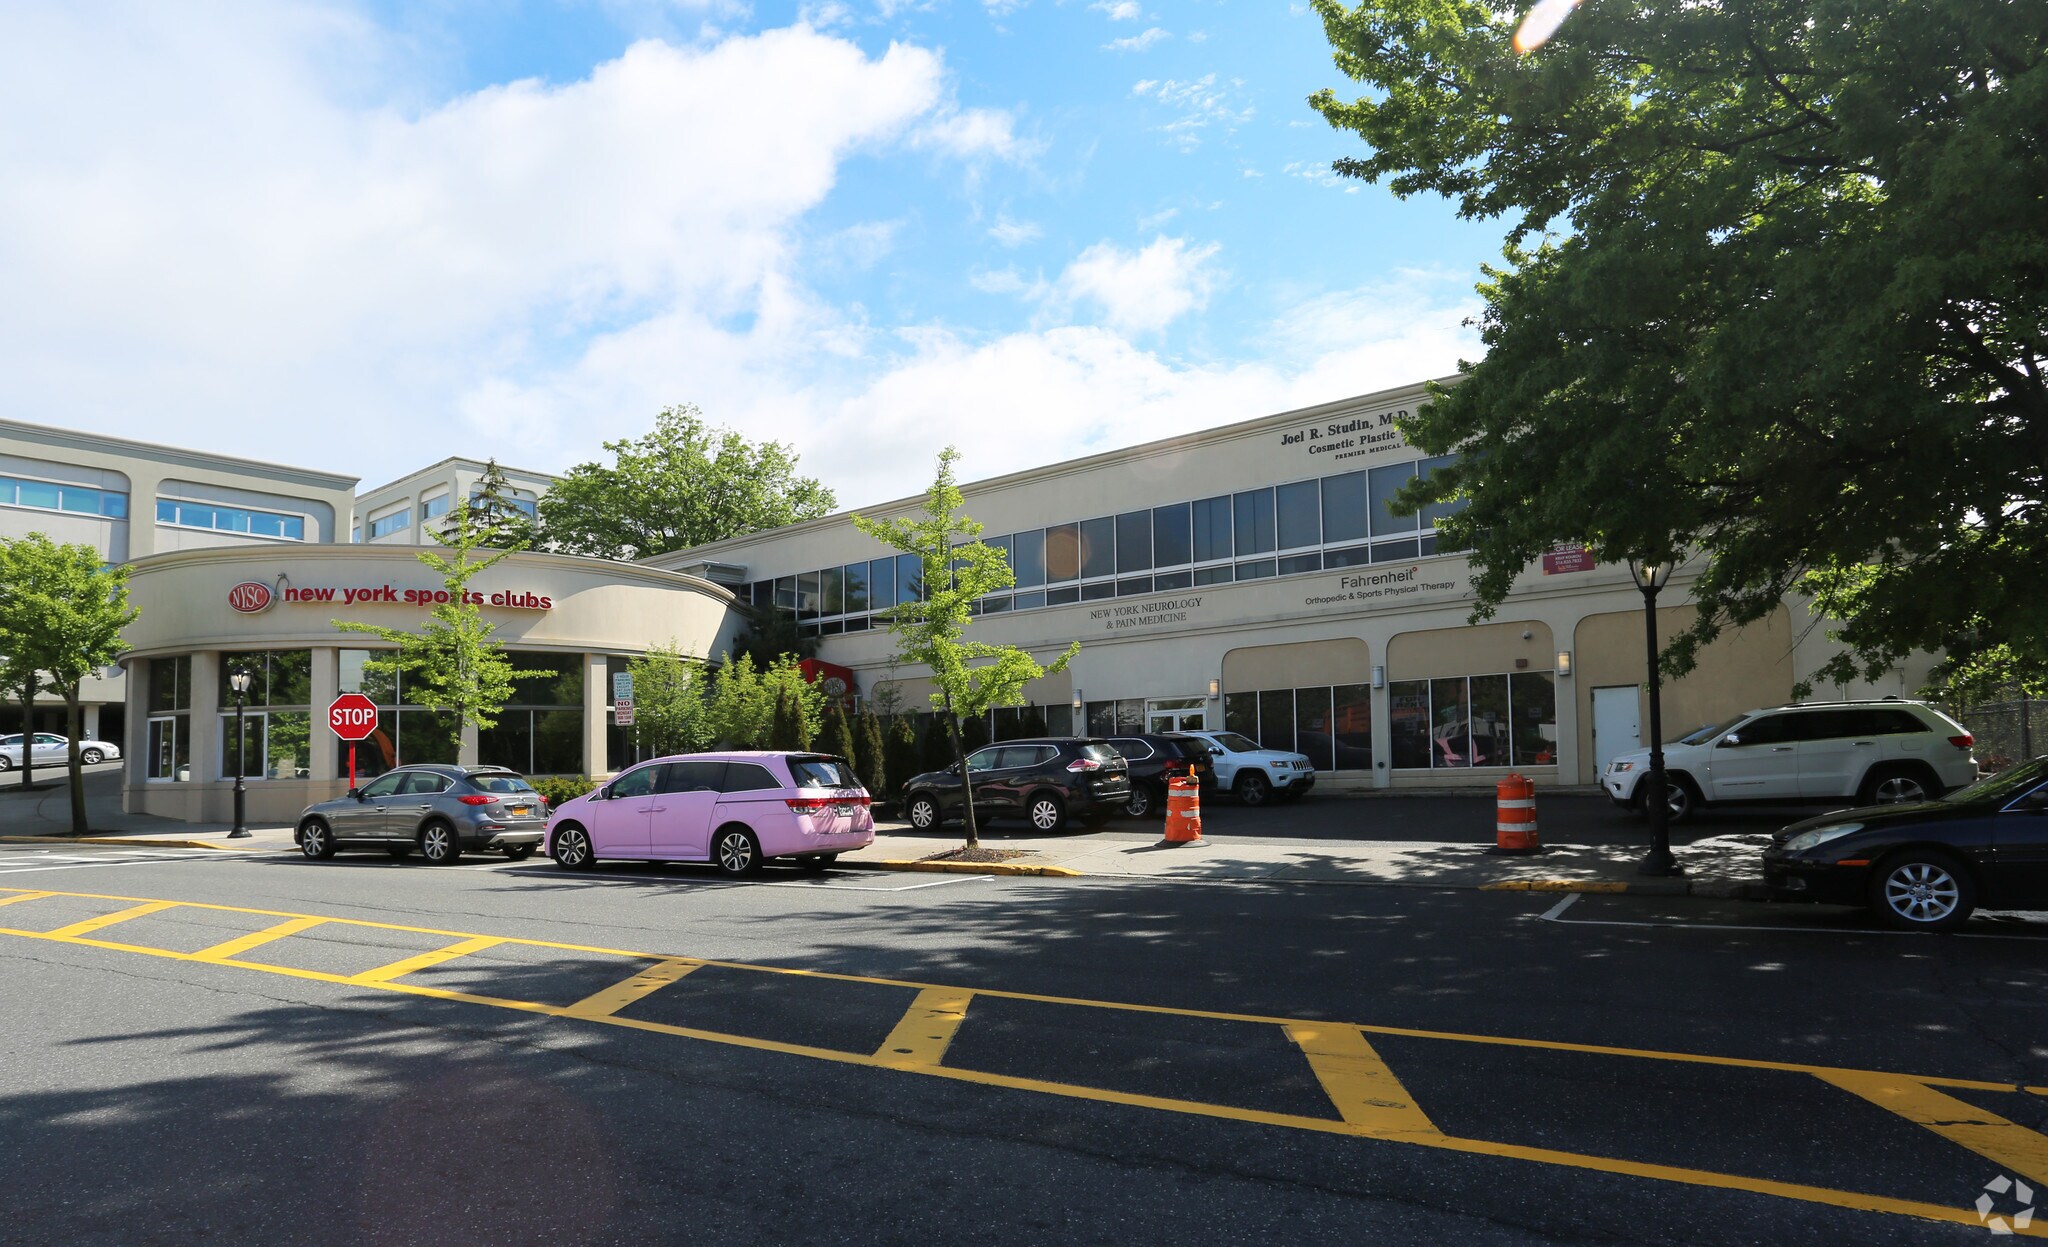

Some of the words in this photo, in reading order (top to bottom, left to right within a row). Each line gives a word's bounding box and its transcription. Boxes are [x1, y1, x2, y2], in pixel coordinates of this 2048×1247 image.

[1281, 431, 1304, 445] Joel
[1310, 428, 1323, 440] R.
[1328, 418, 1373, 436] Studin,
[1308, 438, 1354, 454] Cosmetic
[1359, 431, 1395, 445] Plastic
[1335, 449, 1366, 460] PREMIER
[1369, 444, 1401, 454] MEDICAL
[232, 586, 263, 608] NYSC
[285, 588, 336, 601] new
[343, 584, 398, 605] york
[491, 590, 552, 609] clubs
[1305, 594, 1347, 605] Orthopedic
[1348, 592, 1355, 600] &
[1357, 589, 1382, 600] Sports
[1384, 584, 1418, 596] Physical
[1421, 581, 1455, 591] Therapy
[1090, 608, 1112, 619] NEW
[1113, 605, 1139, 617] YORK
[1141, 597, 1202, 613] NEUROLOGY
[1106, 620, 1113, 629] &
[1116, 617, 1136, 628] PAIN
[1138, 612, 1187, 625] MEDICINE
[332, 708, 374, 725] STOP
